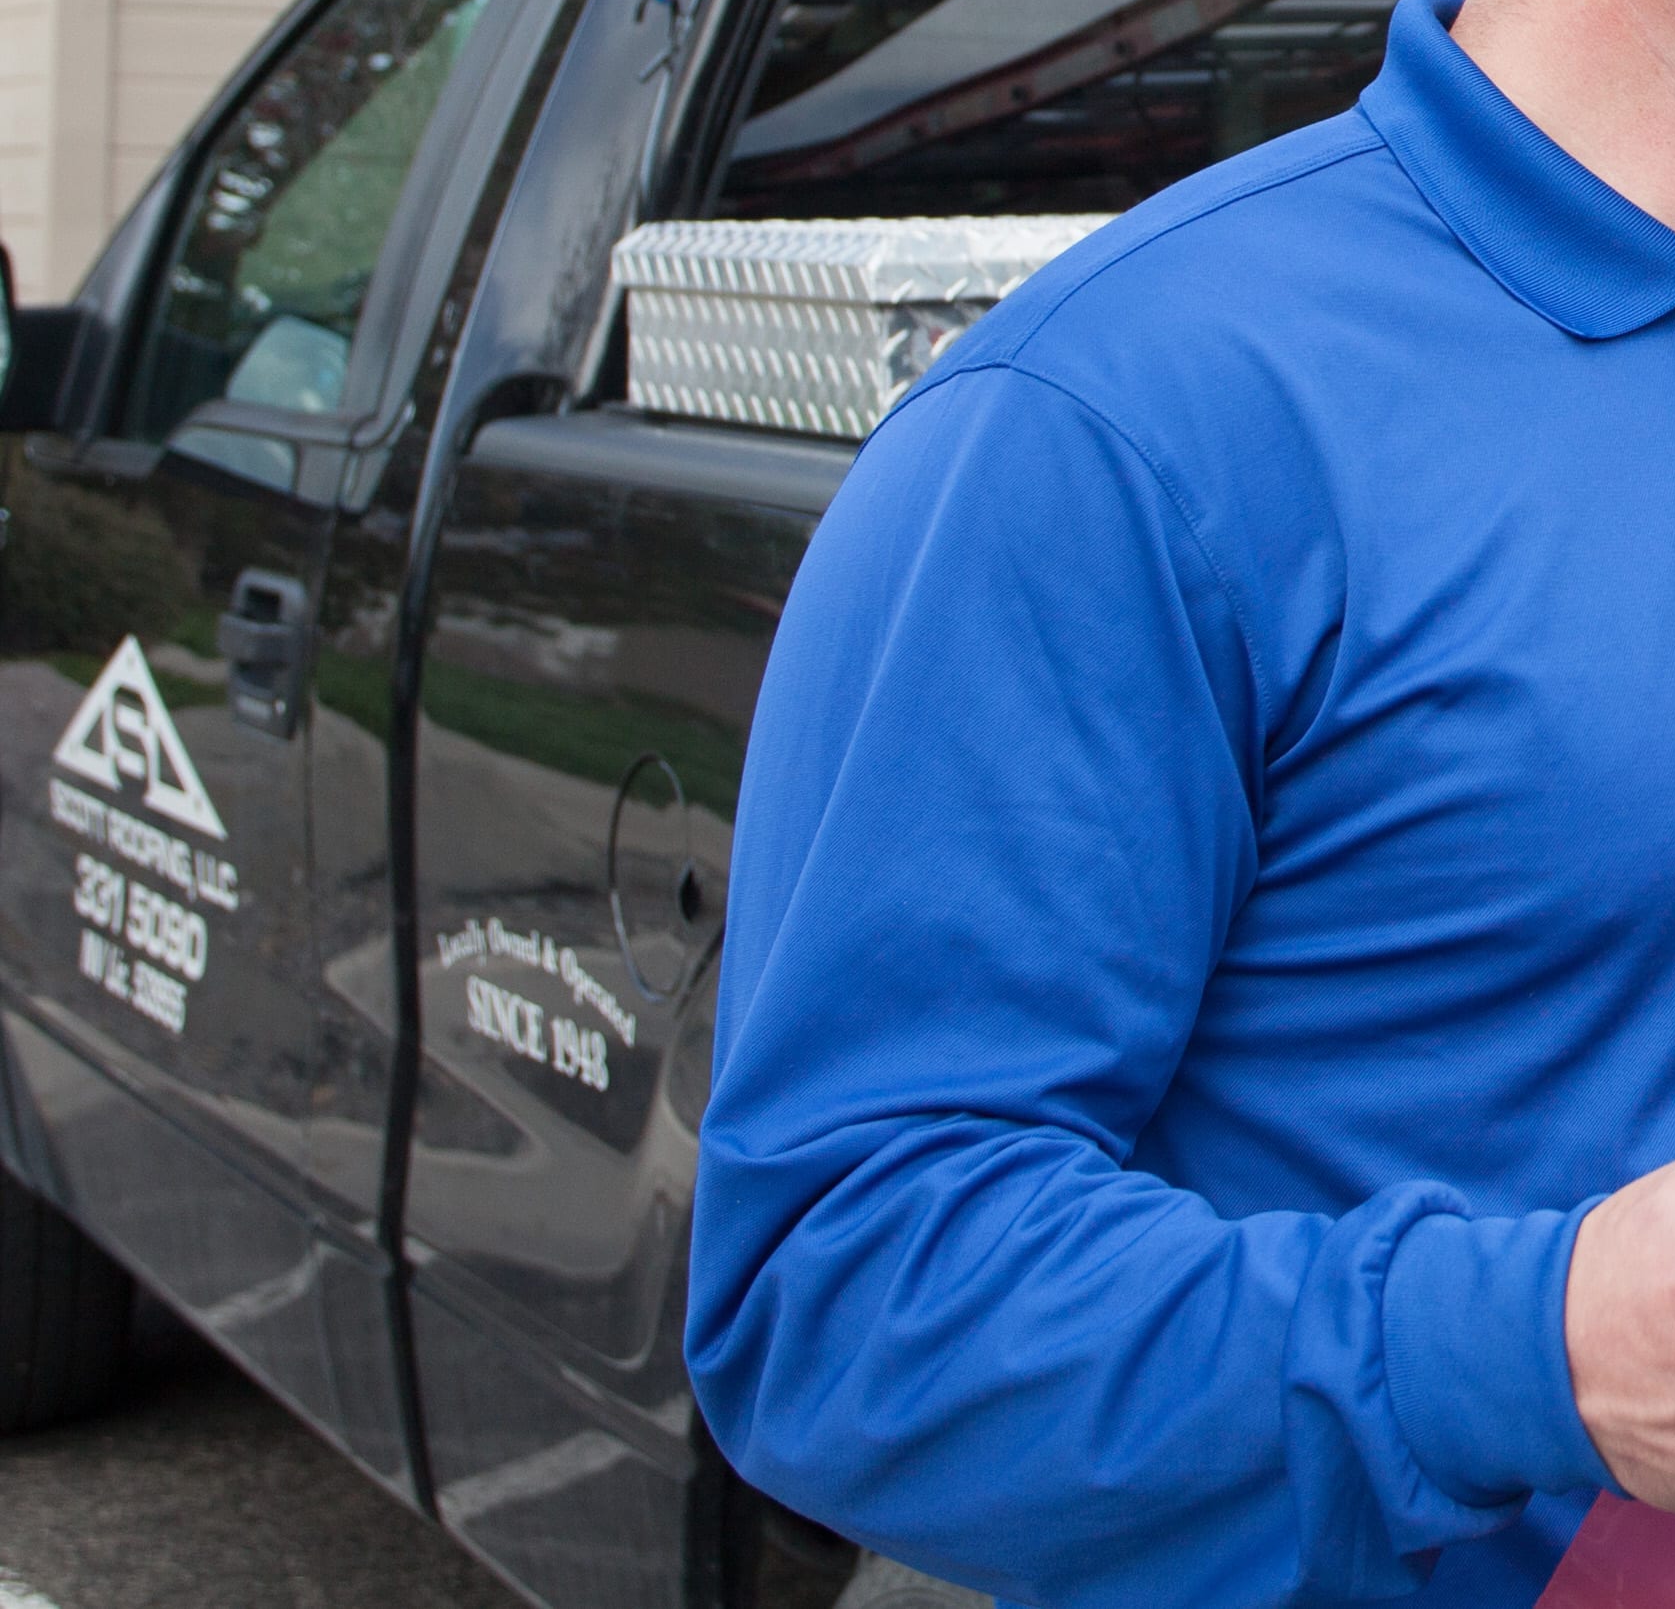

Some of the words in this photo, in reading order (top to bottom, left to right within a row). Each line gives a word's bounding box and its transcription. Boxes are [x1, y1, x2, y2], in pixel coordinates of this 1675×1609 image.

[73, 852, 125, 936] 331
[195, 849, 240, 911] LLC
[466, 974, 547, 1064] SINCE
[551, 1016, 610, 1093] 1948
